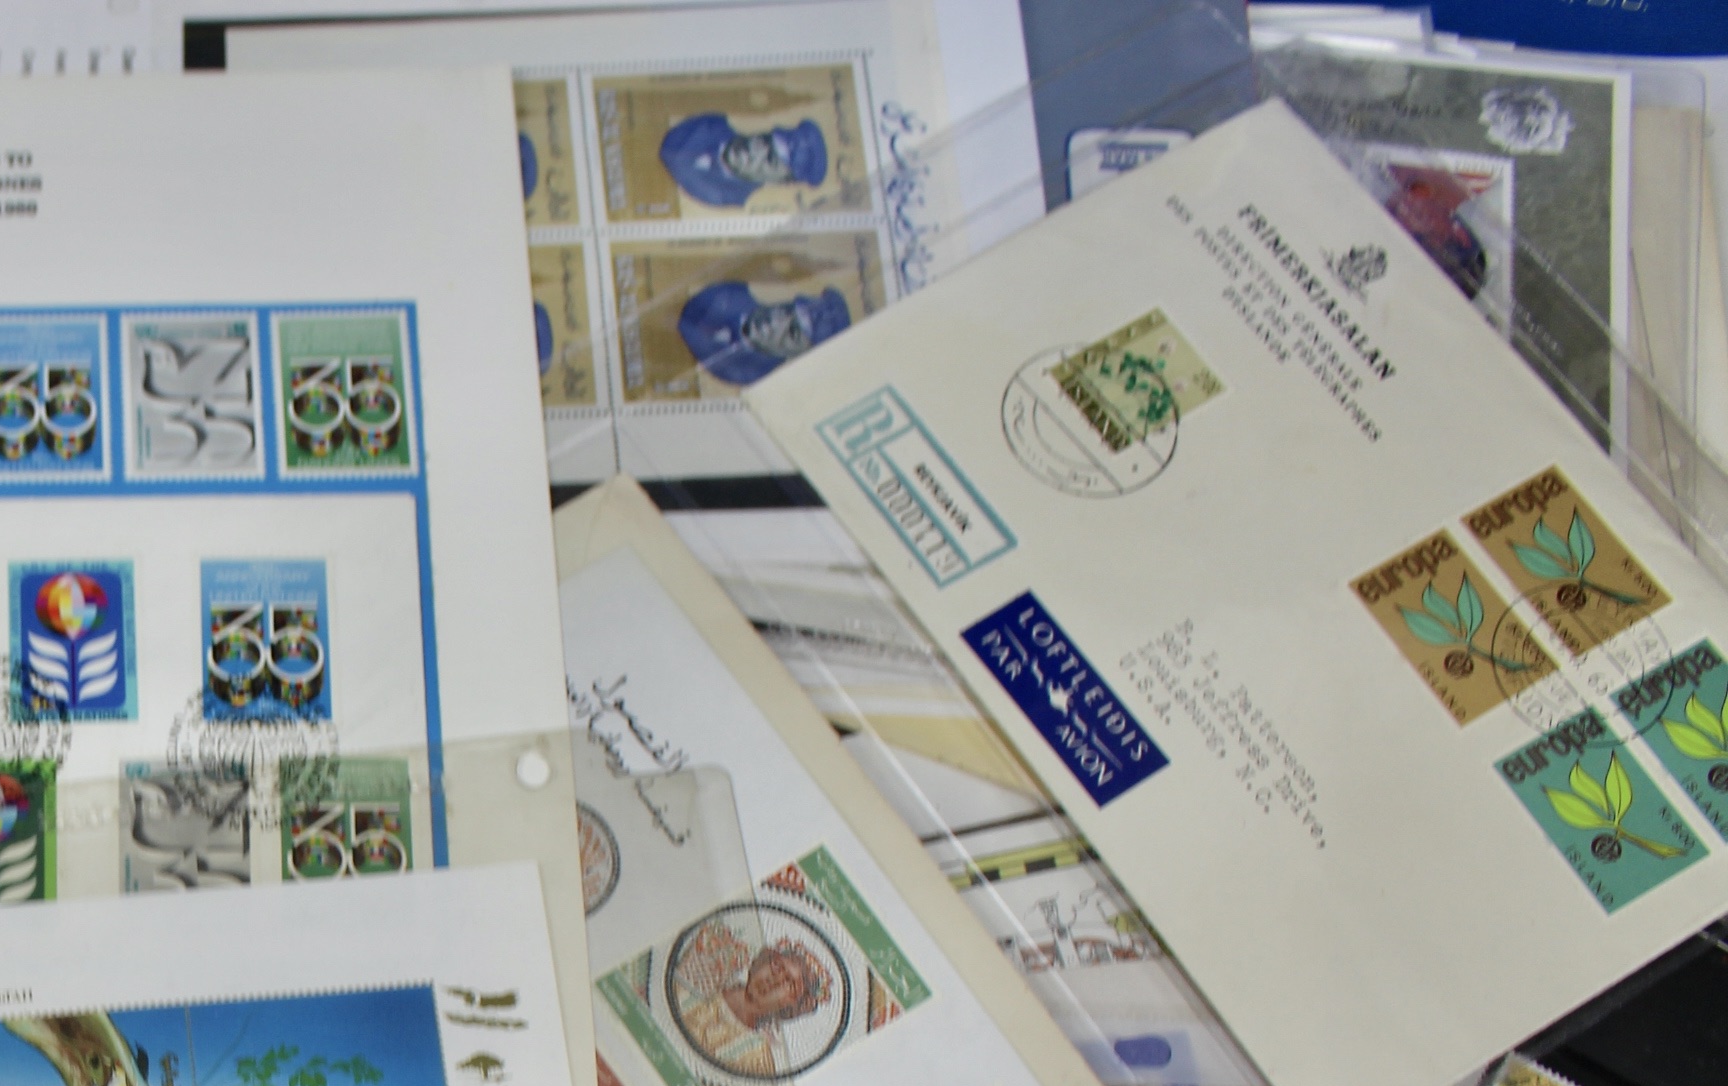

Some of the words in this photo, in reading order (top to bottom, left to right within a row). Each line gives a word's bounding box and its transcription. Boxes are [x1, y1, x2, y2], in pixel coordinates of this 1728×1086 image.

[7, 151, 33, 168] TO
[833, 393, 895, 451] R
[1468, 472, 1570, 541] europa
[1356, 536, 1460, 604] europa
[981, 627, 1022, 682] PAR
[1056, 723, 1114, 788] AVION
[1616, 645, 1723, 721] europa
[1502, 708, 1606, 785] europa
